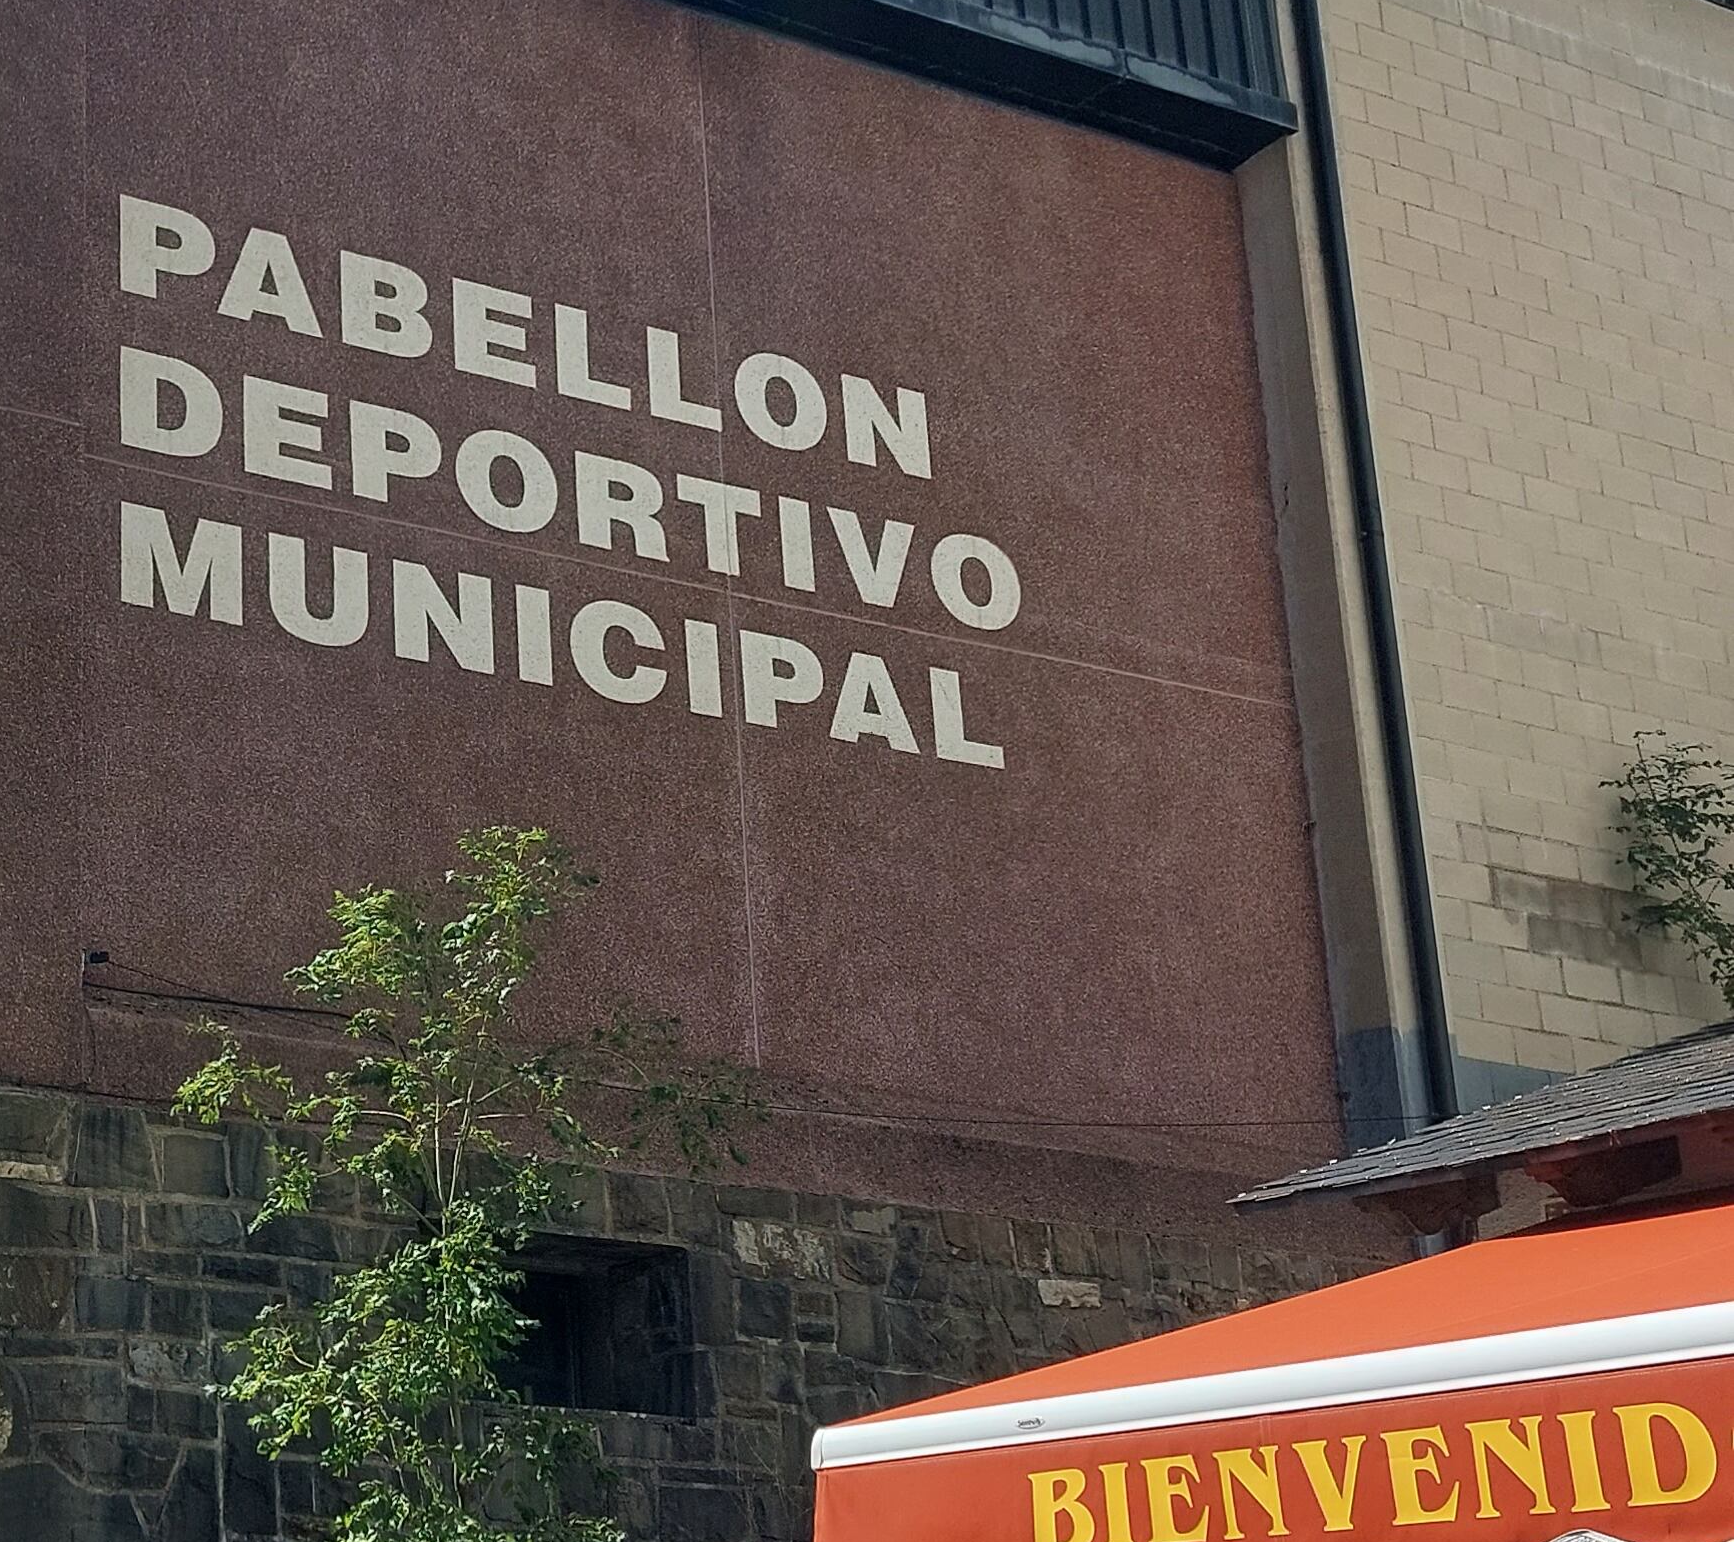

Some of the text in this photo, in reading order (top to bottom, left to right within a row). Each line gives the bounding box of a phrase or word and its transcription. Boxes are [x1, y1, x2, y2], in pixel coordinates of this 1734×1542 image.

[119, 194, 932, 480] PABELLON
[120, 346, 1023, 632] DEPORTIVO
[120, 501, 1005, 769] MUNICIPAL
